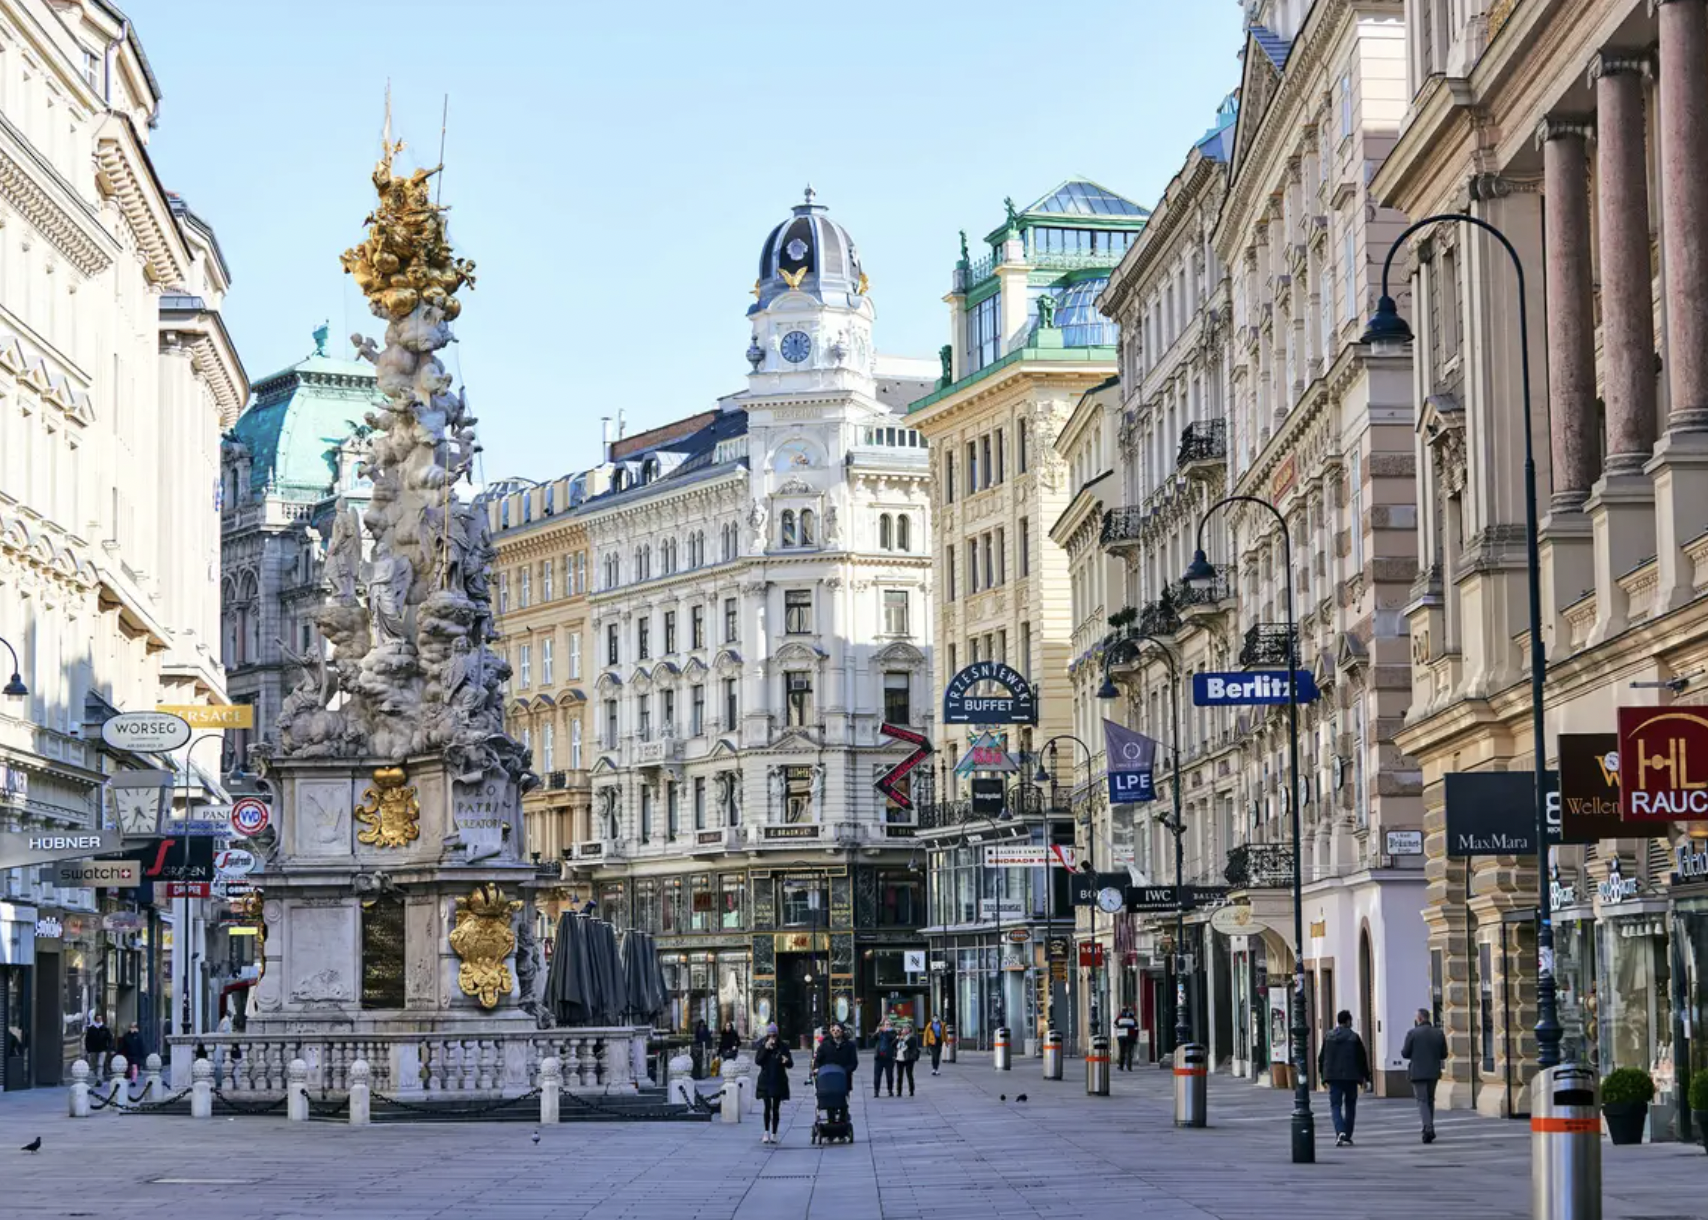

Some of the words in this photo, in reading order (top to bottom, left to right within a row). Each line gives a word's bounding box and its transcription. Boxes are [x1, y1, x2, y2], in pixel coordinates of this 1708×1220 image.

[1207, 675, 1298, 699] Berlitz
[964, 699, 1014, 711] BUFFET
[115, 722, 177, 734] WORSEG
[1116, 773, 1150, 790] LPE
[457, 801, 499, 813] PATRI
[1459, 833, 1528, 849] MaxMara
[60, 867, 120, 879] swatch
[1145, 889, 1171, 901] IWC
